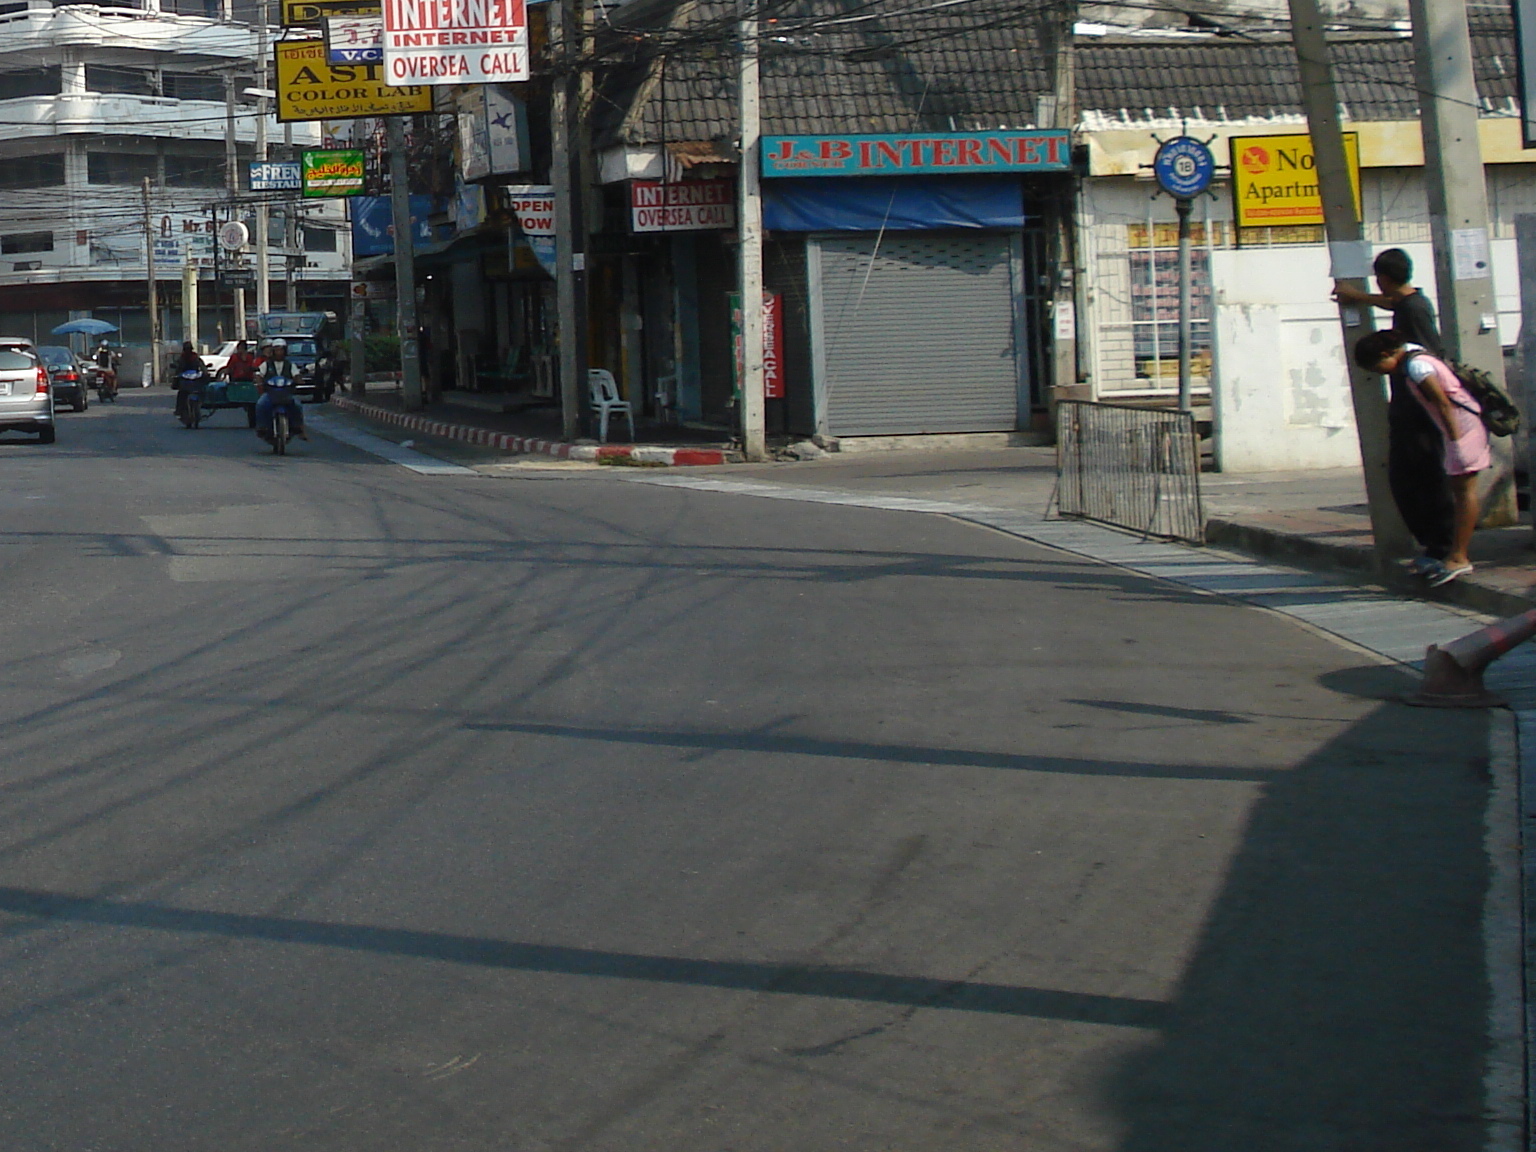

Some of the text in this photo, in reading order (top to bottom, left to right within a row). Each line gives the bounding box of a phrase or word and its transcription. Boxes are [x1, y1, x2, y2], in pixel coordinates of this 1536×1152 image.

[393, 30, 518, 47] INTERNET
[290, 64, 384, 86] ASI
[393, 52, 521, 78] OVERSEA CALL
[287, 85, 423, 103] COLOR LAB
[767, 135, 1069, 169] J&B INTERNET
[1276, 148, 1315, 171] No
[262, 164, 301, 180] FREN
[252, 180, 301, 189] RESTAU
[1245, 181, 1321, 204] Apartm
[636, 185, 724, 206] INTERNET
[638, 208, 727, 227] OVERSEA CALL
[764, 360, 777, 398] CALL
